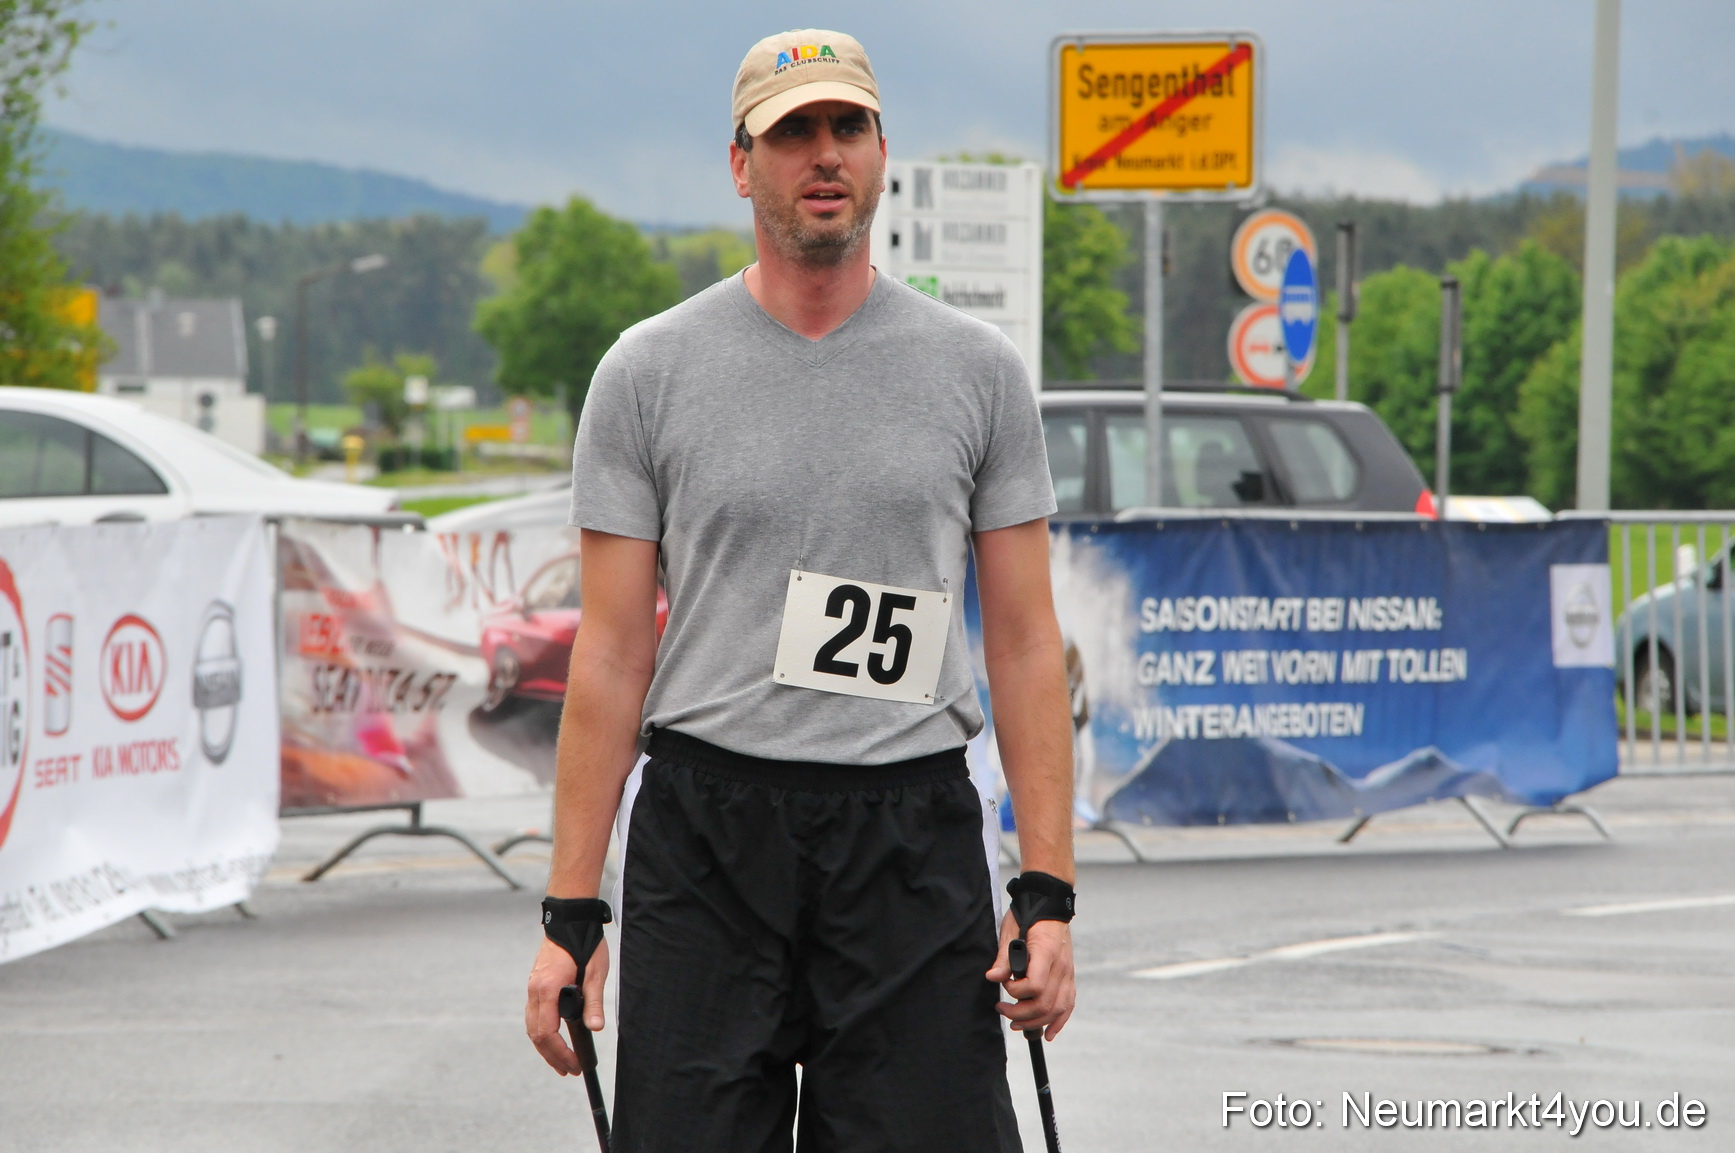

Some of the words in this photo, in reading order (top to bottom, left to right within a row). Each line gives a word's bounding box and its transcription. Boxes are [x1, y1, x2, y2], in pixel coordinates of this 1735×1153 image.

[776, 45, 837, 69] AIDA
[1077, 63, 1236, 108] Sengenthal
[1140, 596, 1303, 632] SAISONSTART
[1306, 598, 1343, 631] BEI
[1348, 596, 1443, 631] NISSAN:
[813, 584, 912, 685] 25
[111, 641, 153, 695] KIA
[1137, 651, 1216, 686] GANZ
[1270, 648, 1337, 685] VORN
[1341, 649, 1383, 684] MIT
[1385, 648, 1467, 682] TOLLEN
[1132, 703, 1365, 739] WINTERANGEBOTEN
[34, 754, 82, 788] SEAT
[92, 745, 113, 779] KIA
[117, 737, 181, 776] MOTORS
